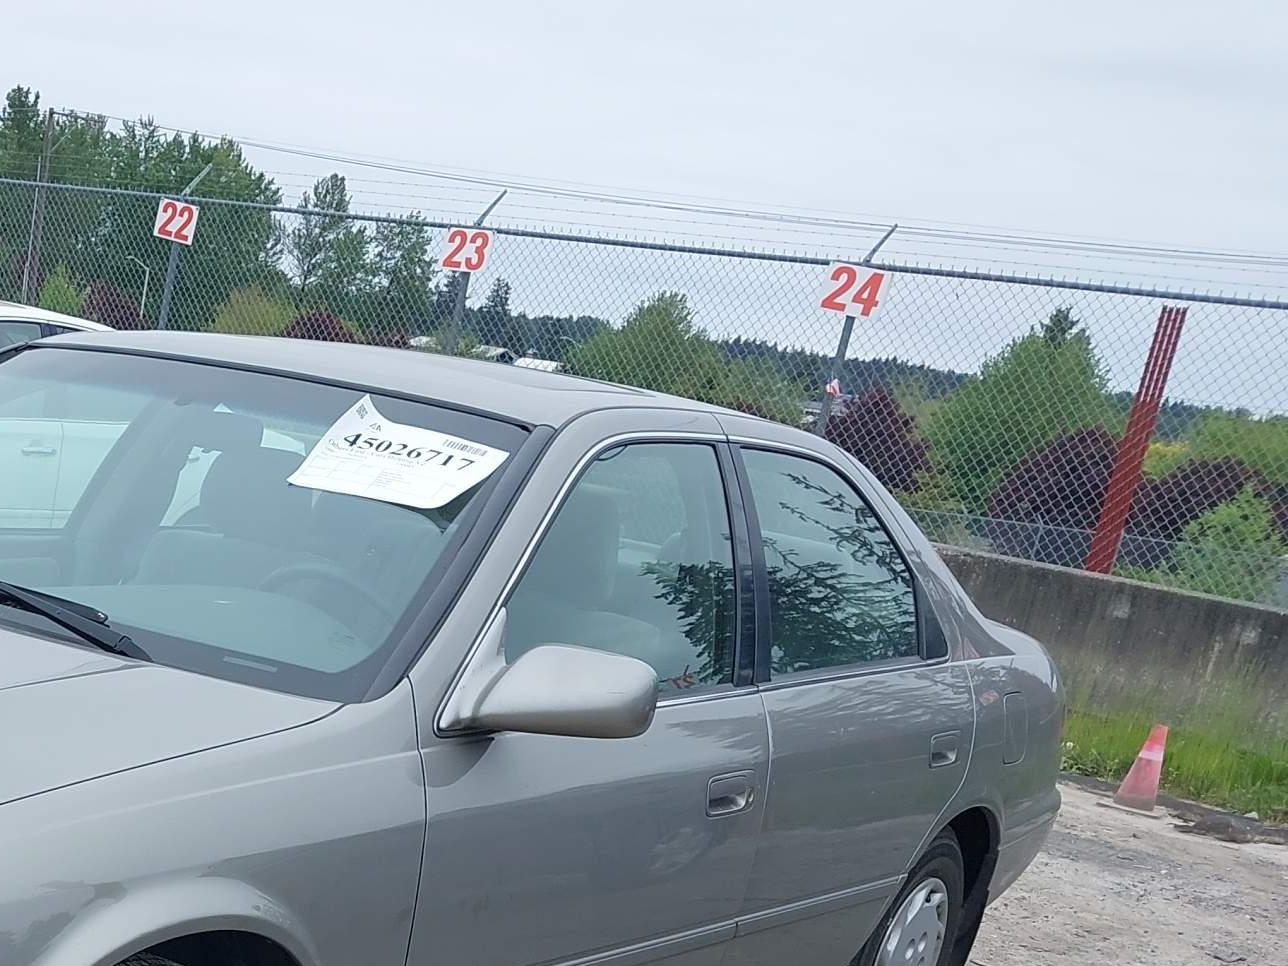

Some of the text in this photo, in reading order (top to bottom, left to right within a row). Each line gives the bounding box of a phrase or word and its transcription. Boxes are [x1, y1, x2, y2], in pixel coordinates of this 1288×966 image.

[157, 201, 195, 242] 22
[442, 229, 490, 271] 23
[819, 265, 885, 317] 24
[343, 433, 476, 471] 45026717
